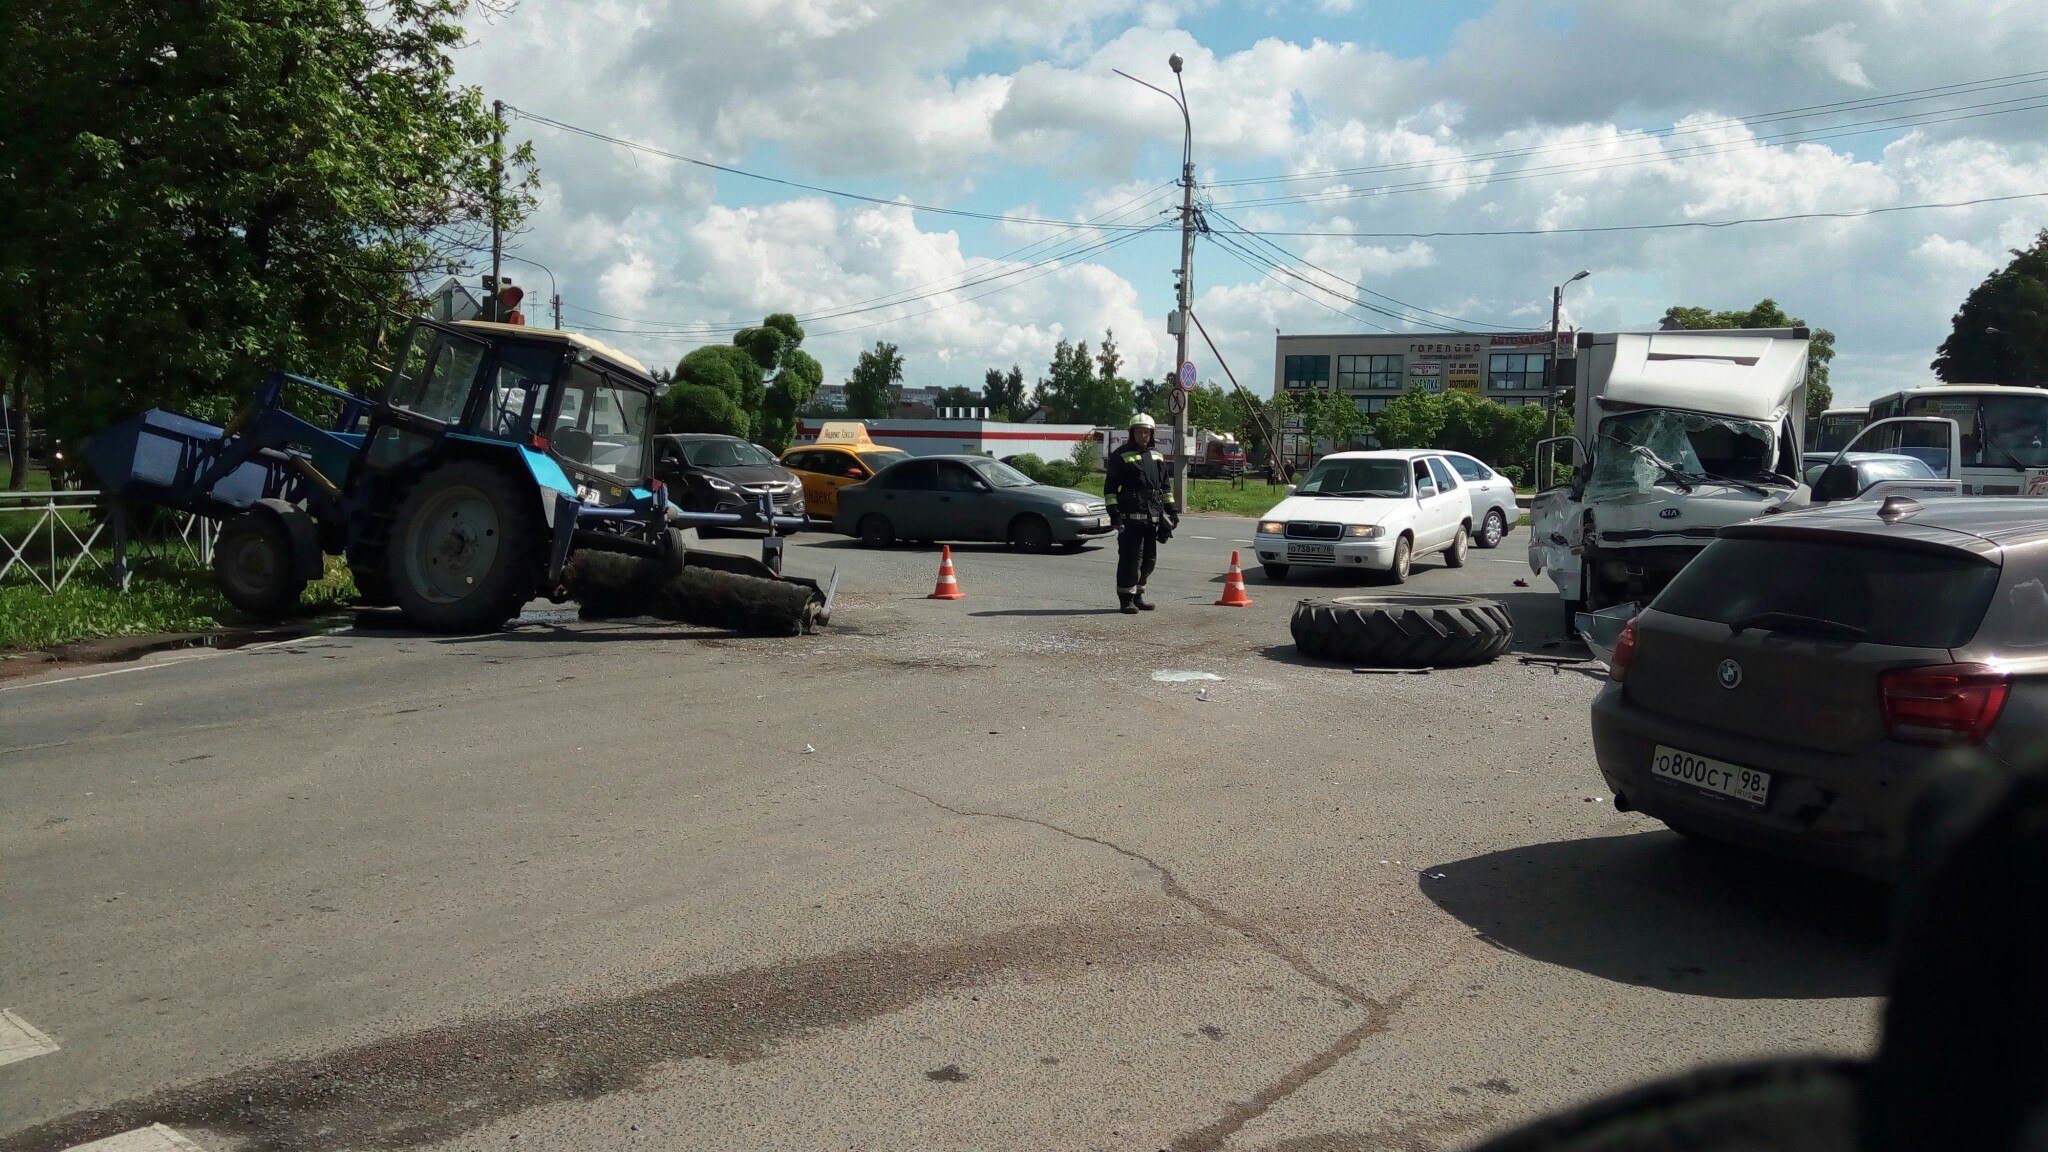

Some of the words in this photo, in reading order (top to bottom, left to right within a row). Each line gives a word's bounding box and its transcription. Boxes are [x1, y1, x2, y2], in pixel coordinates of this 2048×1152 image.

[1410, 343, 1480, 353] ГОРЕЛОВО
[1661, 509, 1678, 517] KIA
[1741, 770, 1761, 792] 98
